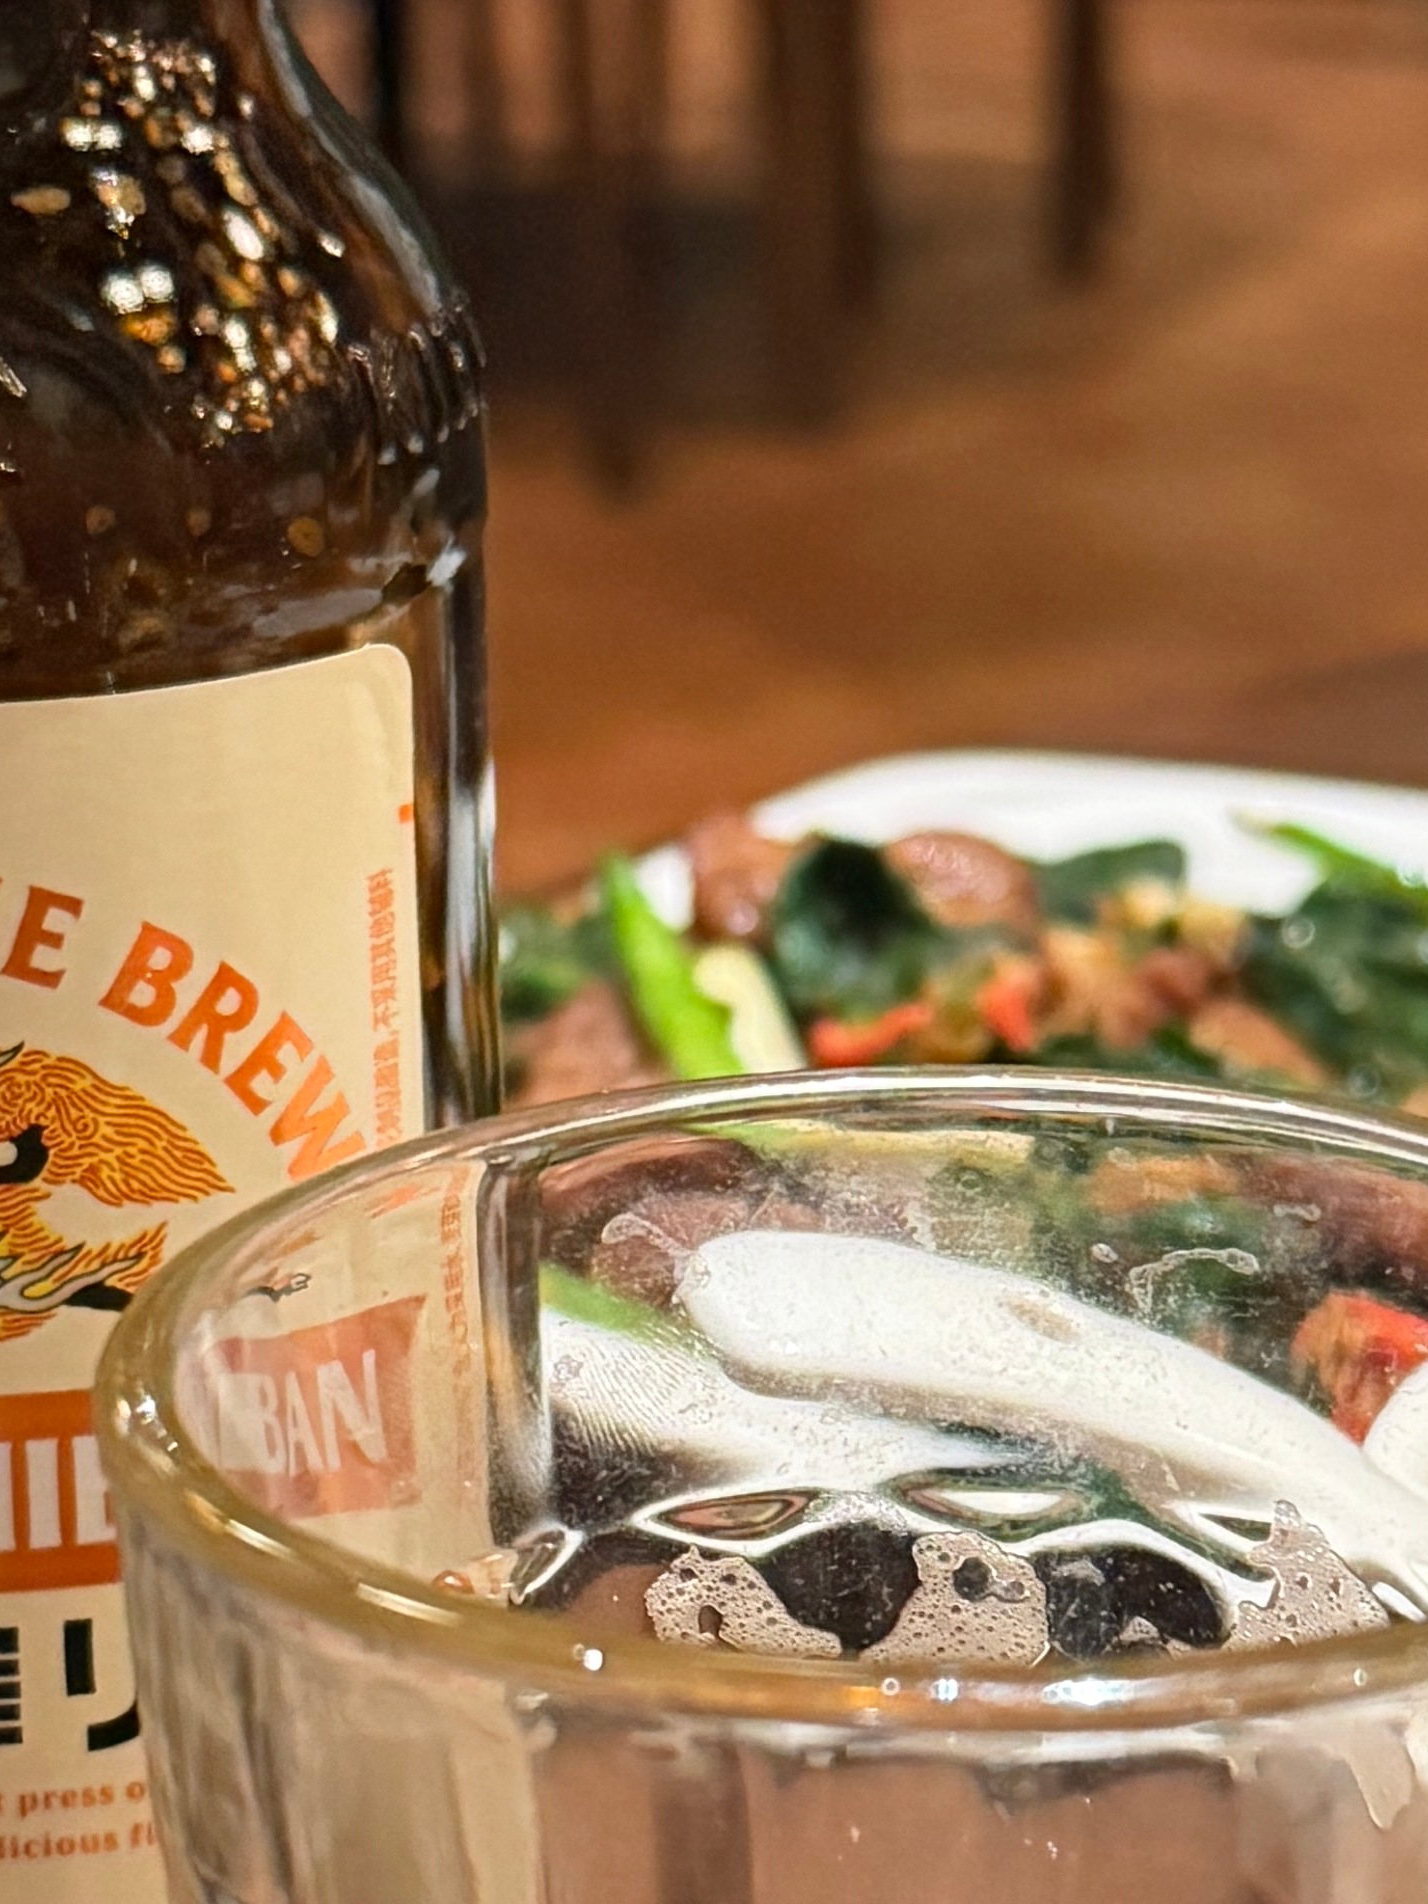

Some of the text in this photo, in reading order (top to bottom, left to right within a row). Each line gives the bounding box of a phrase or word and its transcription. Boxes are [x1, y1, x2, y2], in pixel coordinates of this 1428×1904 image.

[97, 920, 368, 1182] BREW
[18, 1786, 114, 1819] press
[125, 1780, 147, 1807] o
